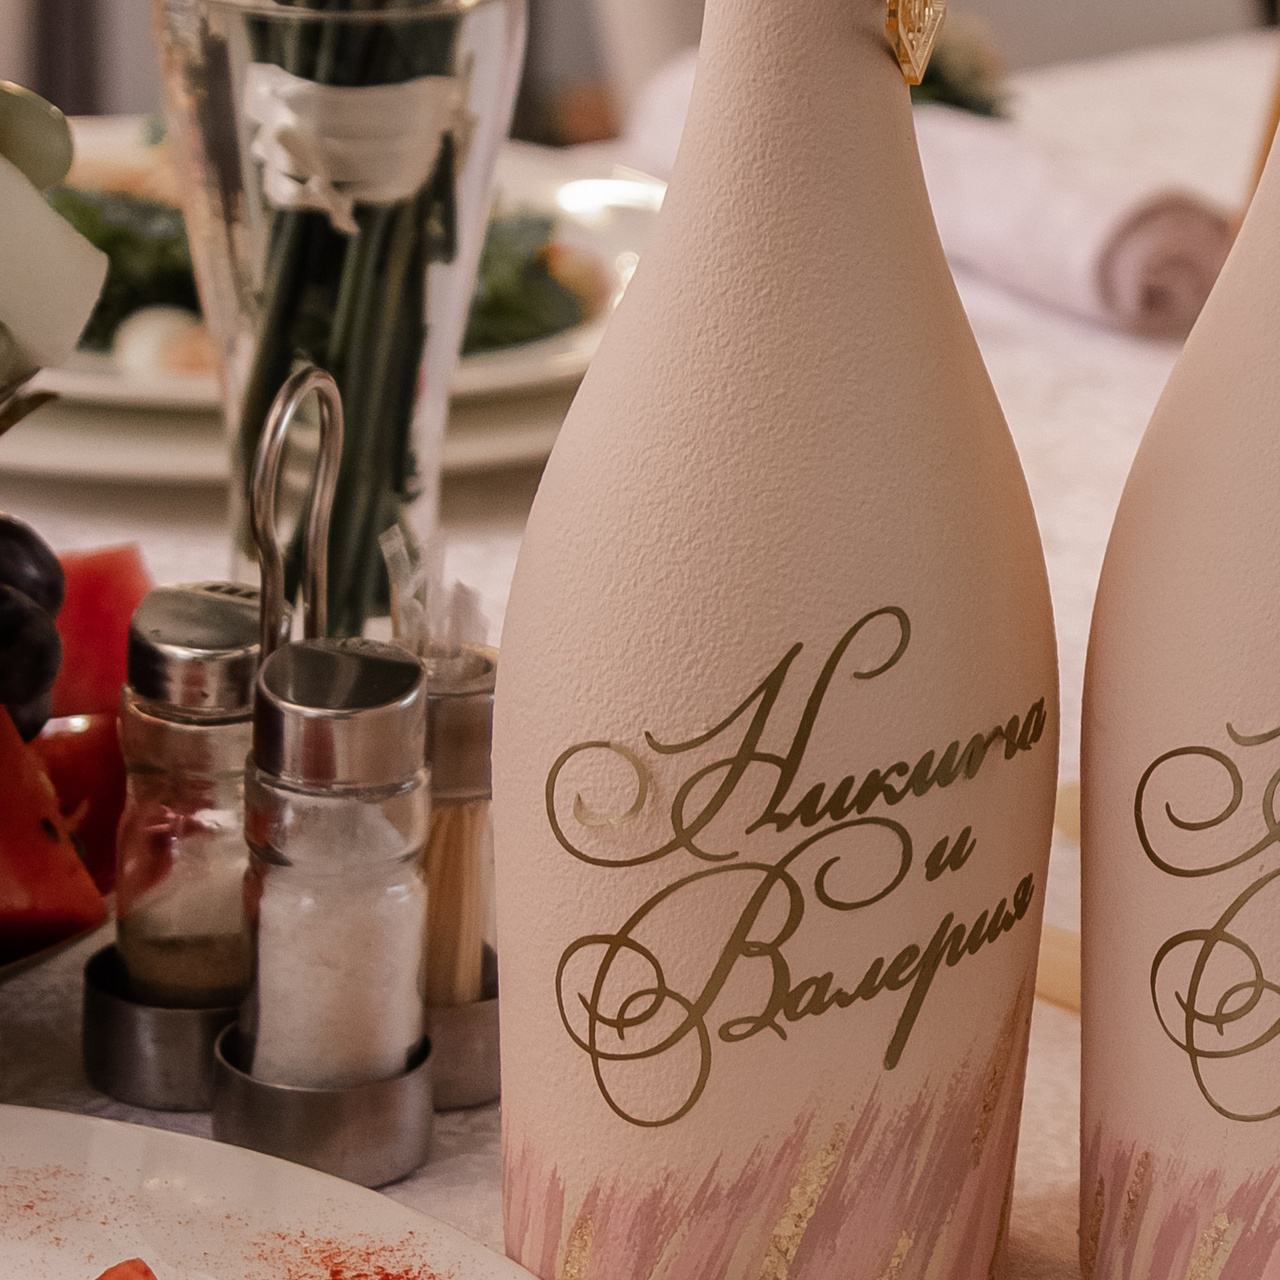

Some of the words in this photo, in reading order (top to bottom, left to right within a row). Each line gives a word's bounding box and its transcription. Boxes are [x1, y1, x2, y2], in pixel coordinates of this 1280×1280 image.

[546, 605, 1048, 868] Никита
[924, 825, 978, 882] и
[555, 816, 1035, 1128] Валерия
